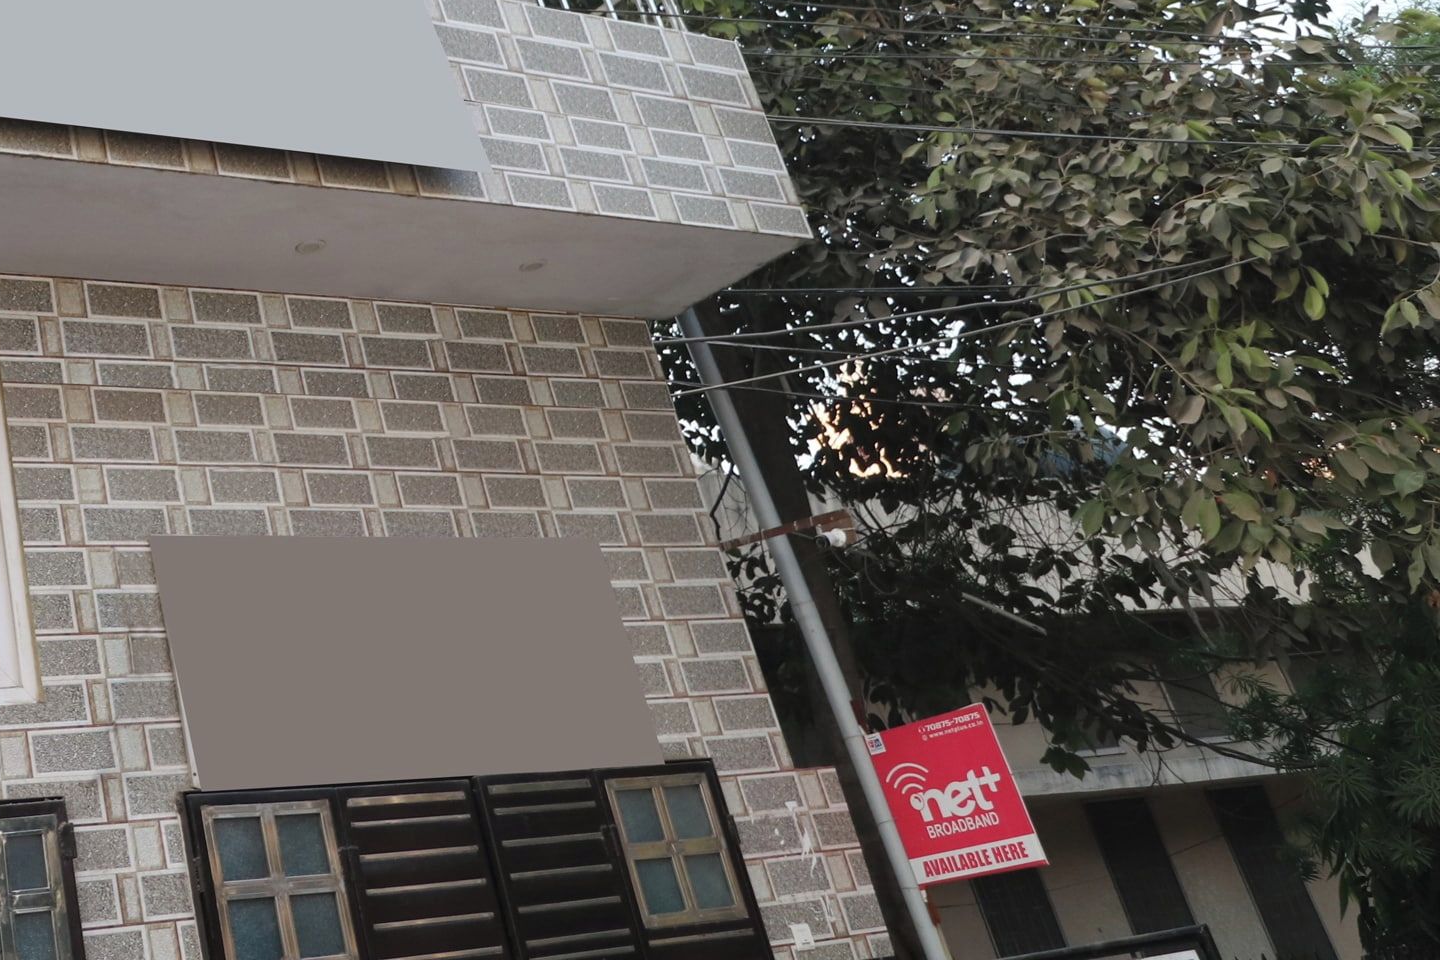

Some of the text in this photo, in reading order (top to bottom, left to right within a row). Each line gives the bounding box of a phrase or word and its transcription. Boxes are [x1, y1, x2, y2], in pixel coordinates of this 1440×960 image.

[924, 711, 981, 732] 70875-70875
[926, 811, 1000, 839] BROADBAND
[923, 841, 1029, 877] AVAILABLE HERE
